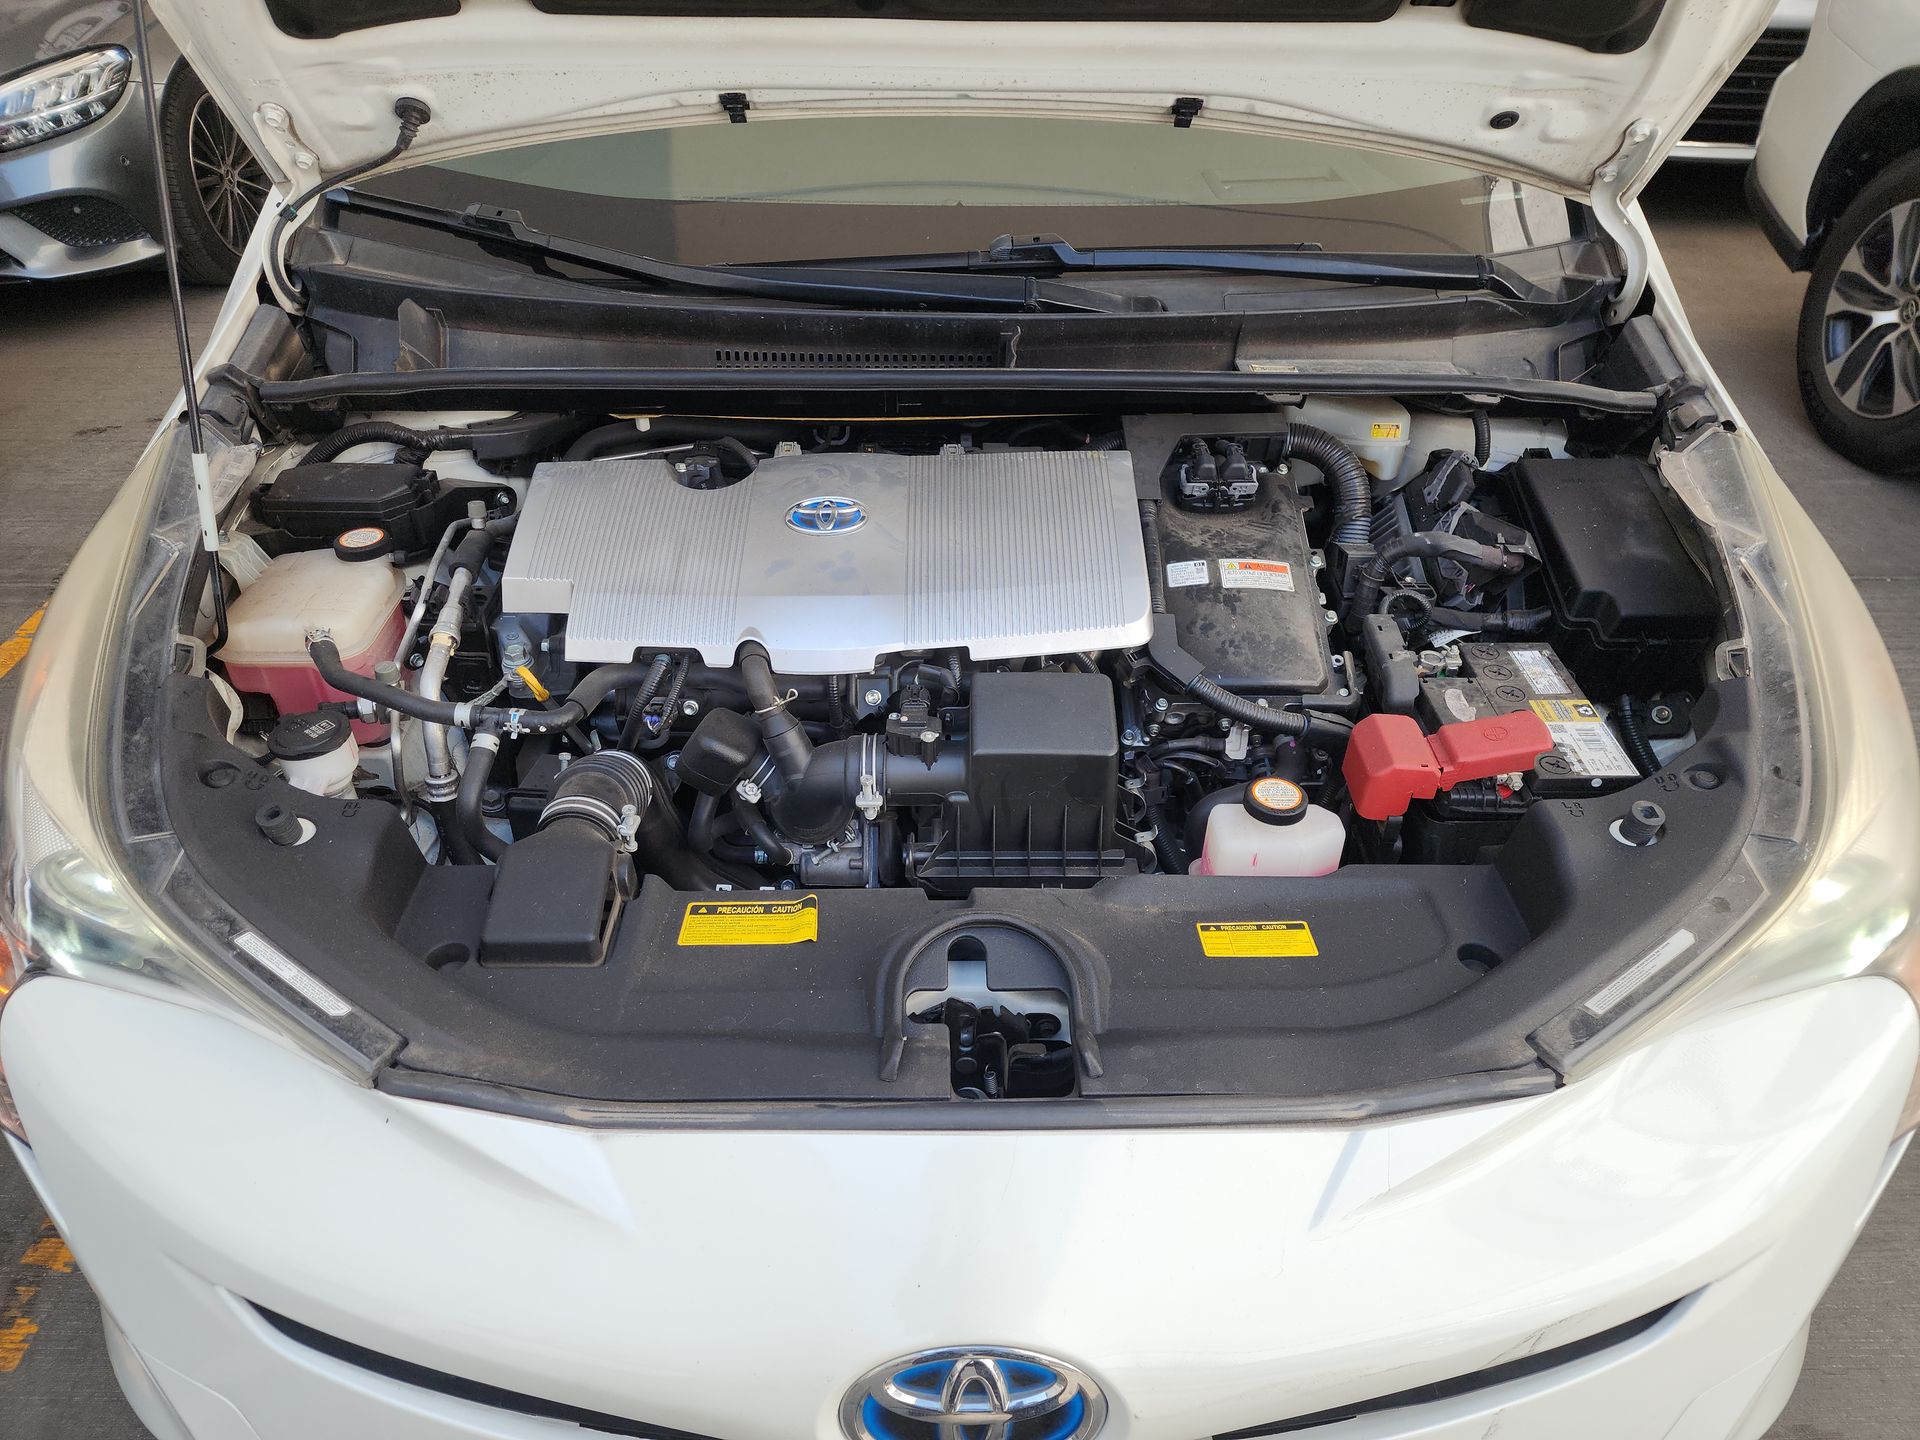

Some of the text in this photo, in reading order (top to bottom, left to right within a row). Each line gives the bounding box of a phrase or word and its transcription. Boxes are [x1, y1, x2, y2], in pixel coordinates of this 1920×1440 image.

[716, 903, 803, 914] PRECAUCIÓN CAUTION
[1220, 923, 1257, 931] PRECAUCIÓN
